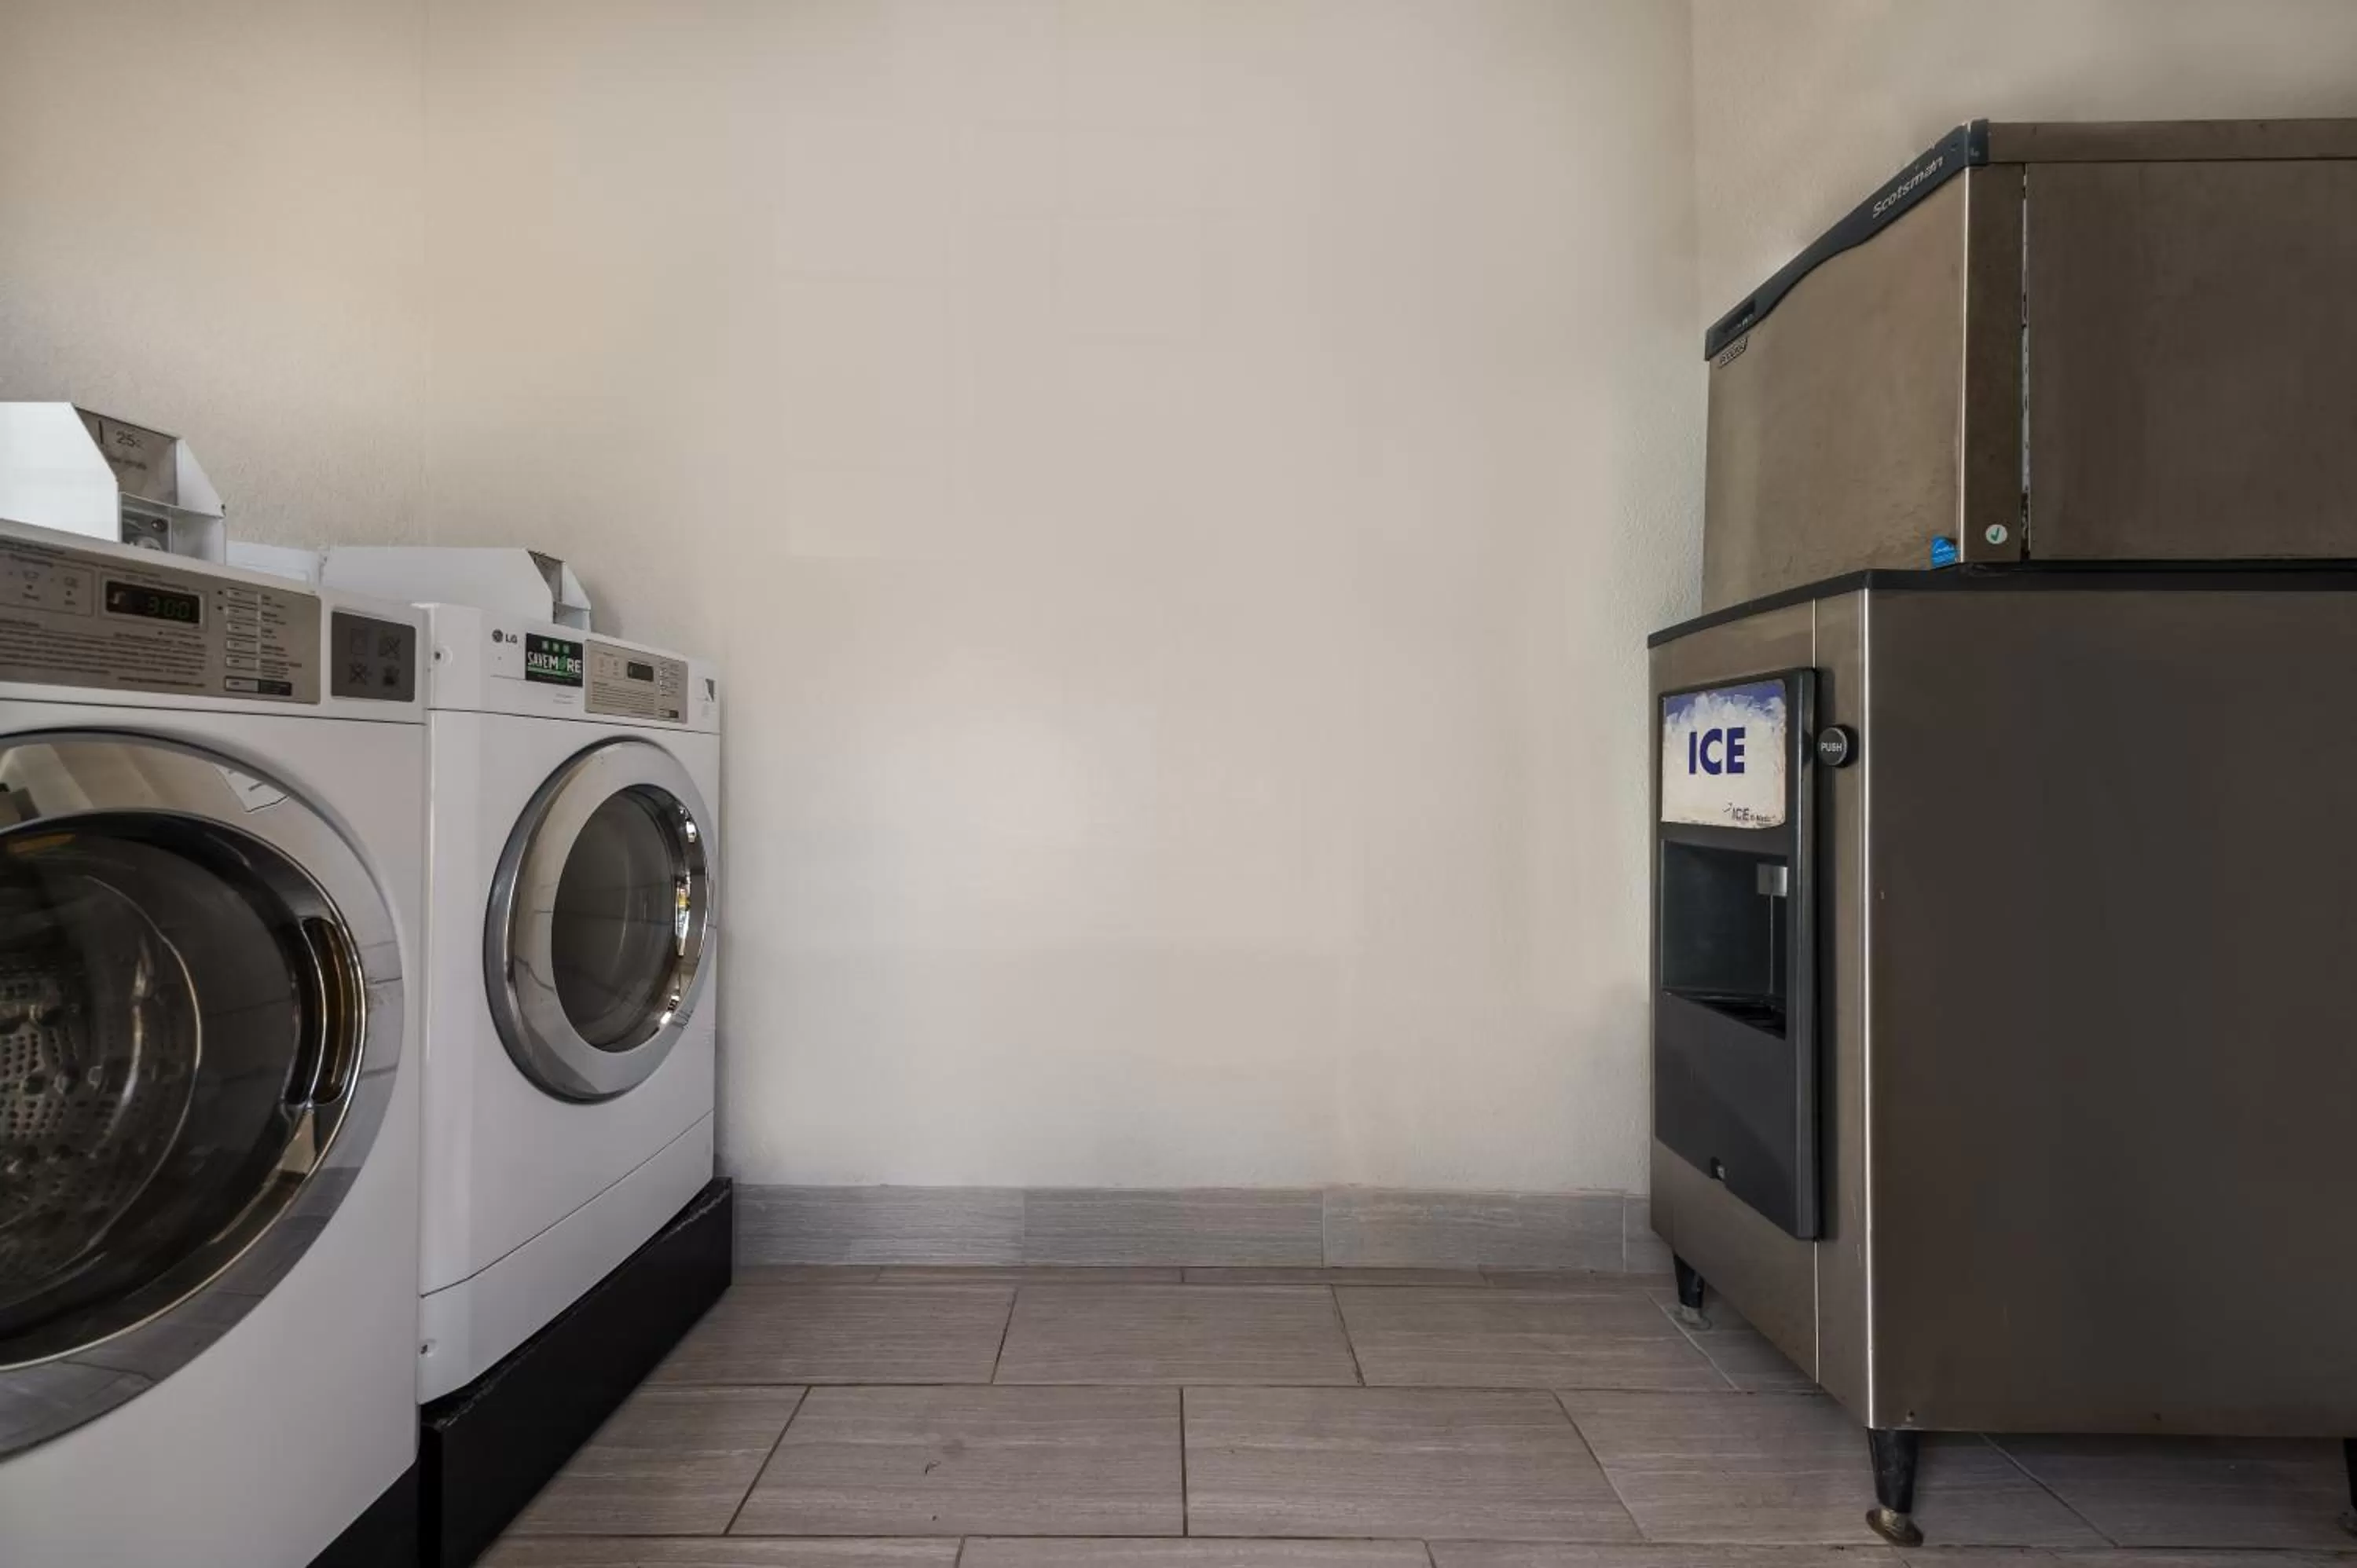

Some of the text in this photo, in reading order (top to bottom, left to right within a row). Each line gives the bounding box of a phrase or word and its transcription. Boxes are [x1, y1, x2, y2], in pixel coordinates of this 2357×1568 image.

[1872, 156, 1944, 219] Scotsman
[505, 633, 518, 643] LG
[1688, 727, 1746, 775] ICE
[1820, 742, 1842, 752] PUSH
